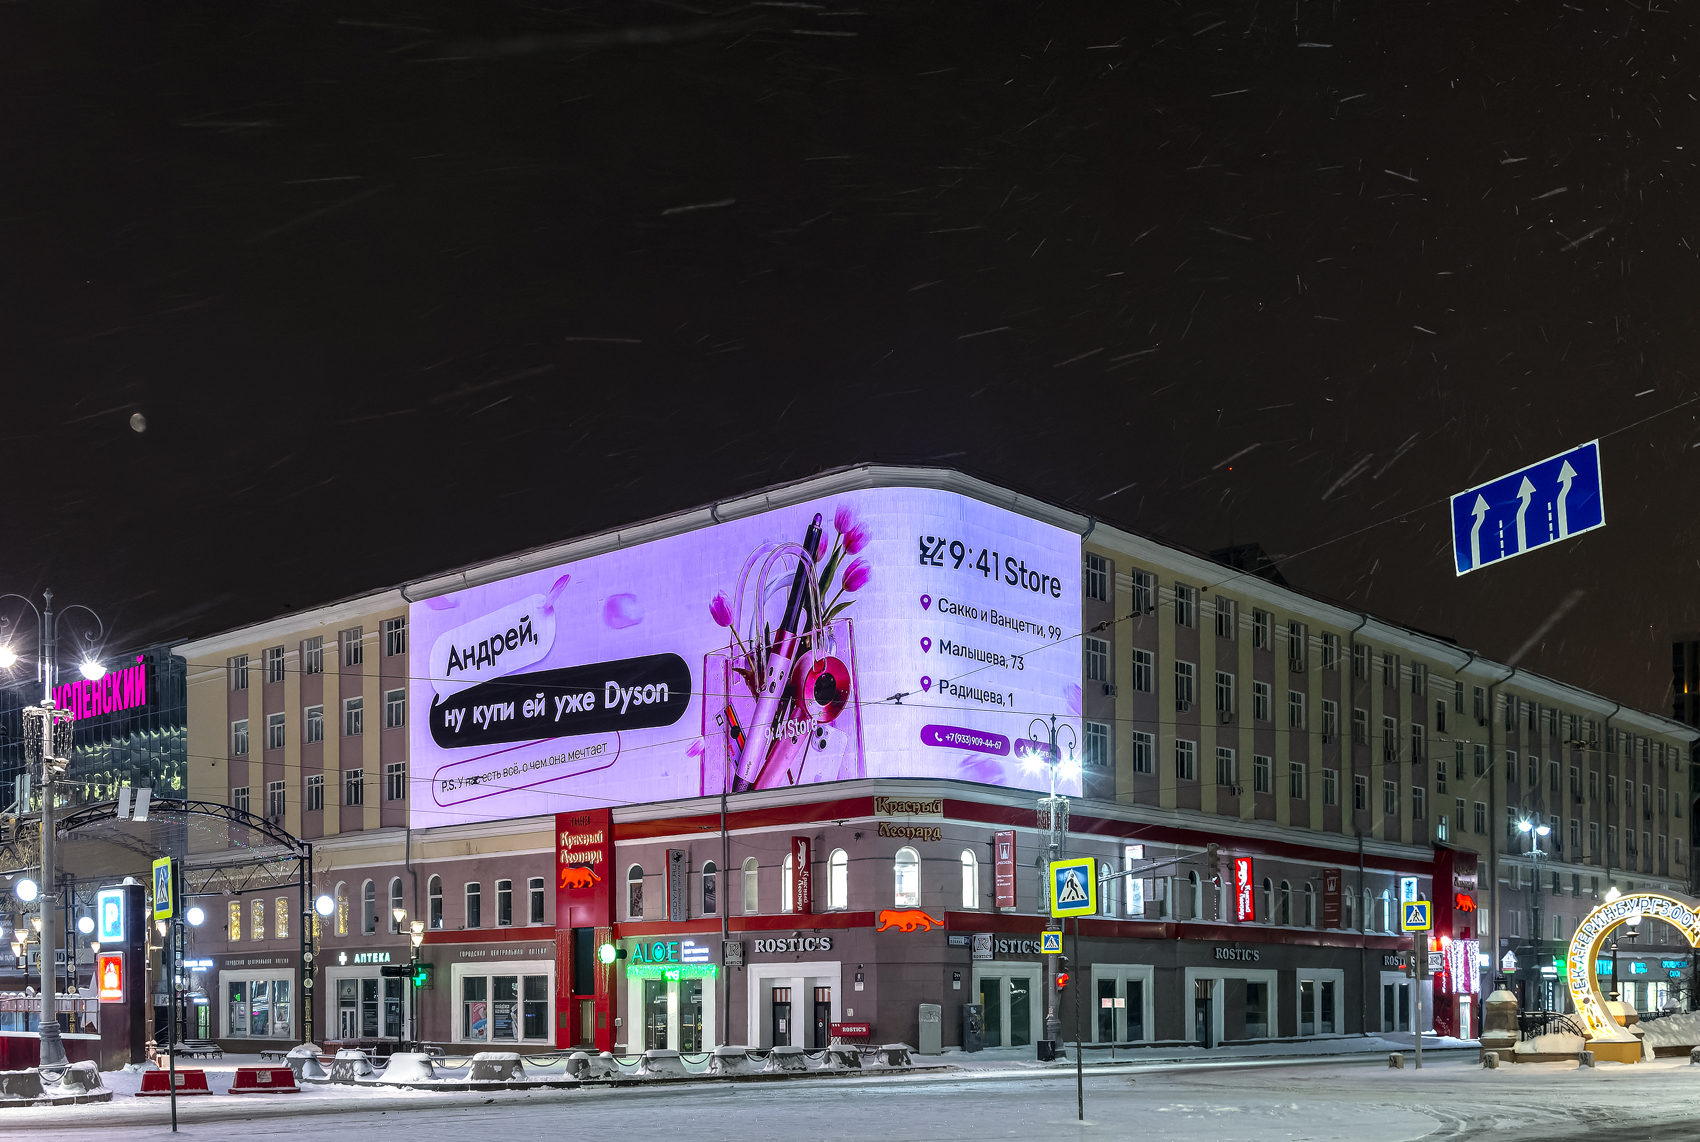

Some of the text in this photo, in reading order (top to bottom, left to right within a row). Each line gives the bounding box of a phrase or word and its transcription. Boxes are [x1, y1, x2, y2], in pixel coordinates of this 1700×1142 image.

[949, 540, 1062, 599] 9:41 Store
[938, 597, 1062, 641] Сакко и Ванцетти, 99
[446, 615, 538, 677] Андрей,
[939, 639, 1025, 671] Малышева, 73
[52, 654, 146, 725] УСПЕНСКИЙ
[939, 679, 1014, 708] Радищева, 1
[444, 680, 669, 733] ну купи ей уже Dyson
[441, 780, 457, 793] P.S.
[458, 776, 464, 785] У
[482, 771, 502, 783] есть
[503, 762, 521, 778] всё,
[522, 763, 528, 773] о
[529, 758, 548, 770] чем
[549, 753, 566, 766] она
[567, 742, 608, 761] мечтает
[875, 796, 944, 816] Красный
[560, 830, 603, 849] Красный
[878, 822, 942, 842] Леопард
[560, 849, 603, 865] Леопард
[354, 952, 391, 963] АПТЕКА
[631, 941, 679, 963] ALOE
[754, 937, 832, 953] ROSTIC'S
[1215, 947, 1260, 961] ROSTIC'S
